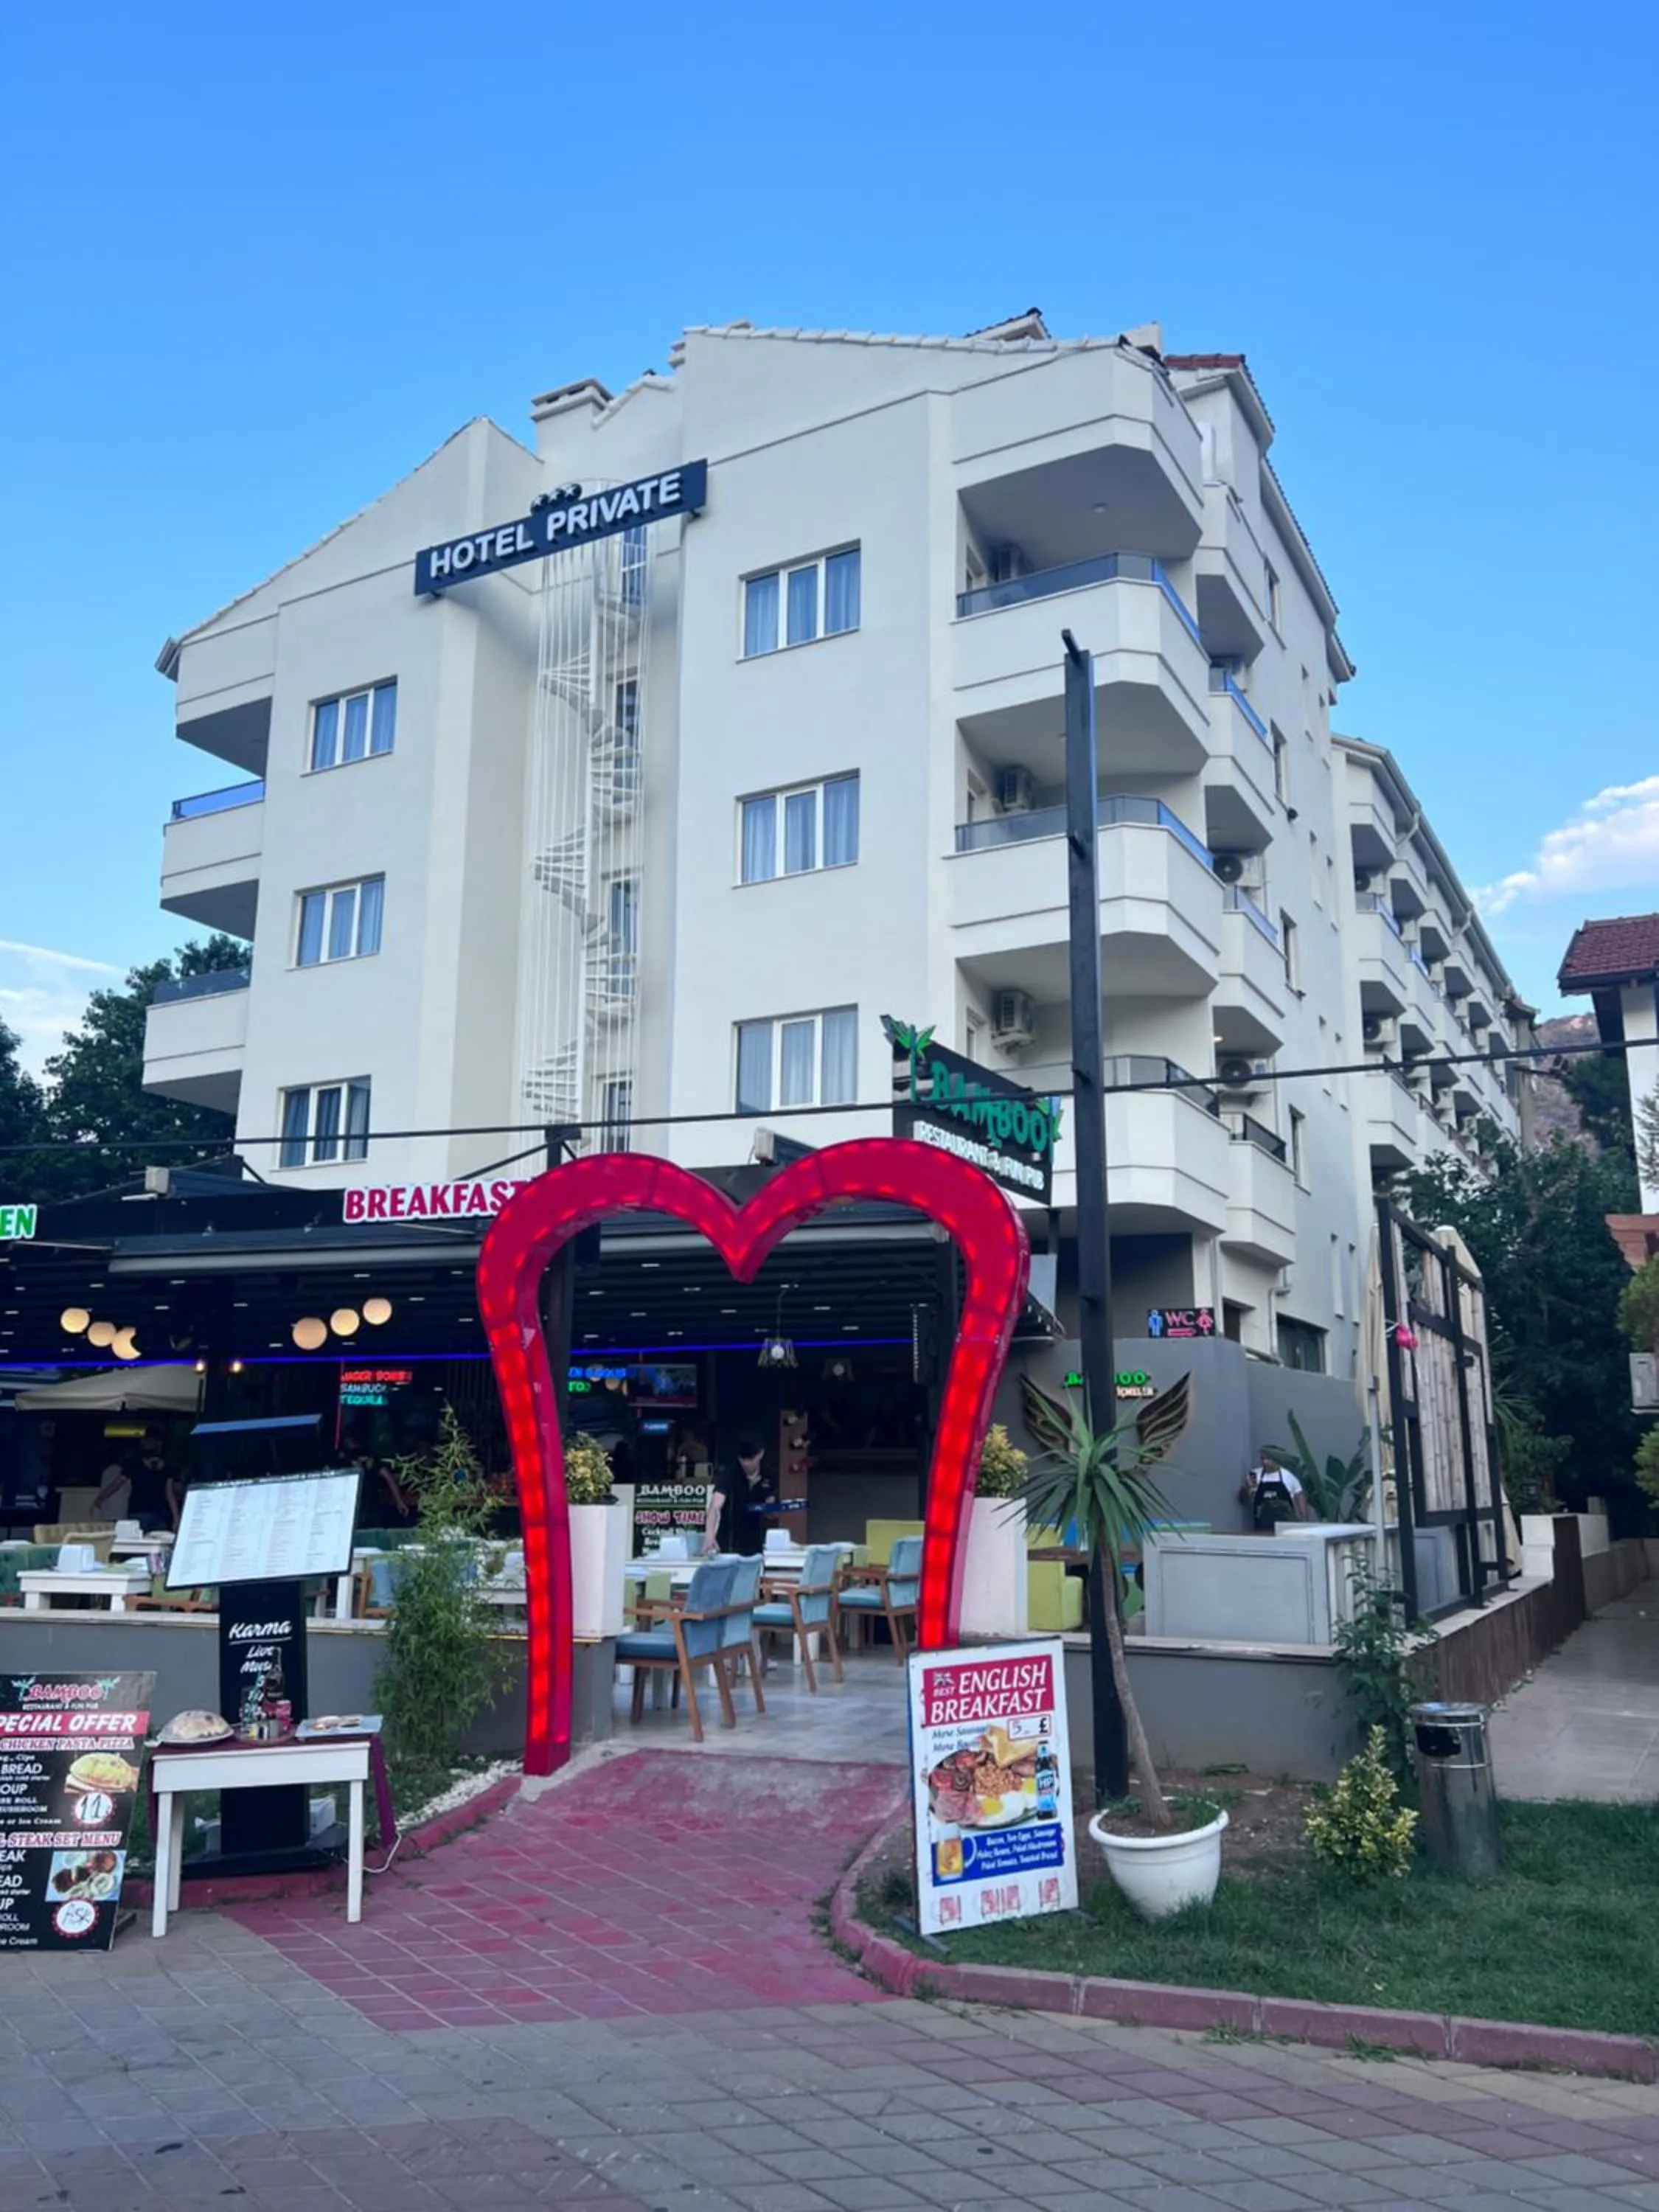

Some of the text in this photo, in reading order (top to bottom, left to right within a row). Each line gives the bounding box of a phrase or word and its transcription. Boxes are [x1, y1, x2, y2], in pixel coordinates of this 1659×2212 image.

[430, 472, 682, 578] HOTEL PRIVATE
[928, 1060, 1048, 1153] BAMBOO
[1165, 1311, 1195, 1326] WC
[636, 1484, 706, 1499] BAMBOO
[636, 1509, 705, 1525] SHOW TIME
[229, 1621, 292, 1639] Karma
[959, 1661, 1047, 1695] ENGLISH
[25, 1684, 103, 1703] BAMBOO
[933, 1686, 955, 1697] BEST
[931, 1688, 1047, 1724] BREAKFAST
[69, 1713, 137, 1732] OFFER
[1, 1763, 43, 1775] BREAD
[0, 1783, 28, 1795] OUP
[7, 1832, 54, 1847] STEAK
[80, 1831, 122, 1846] MENU
